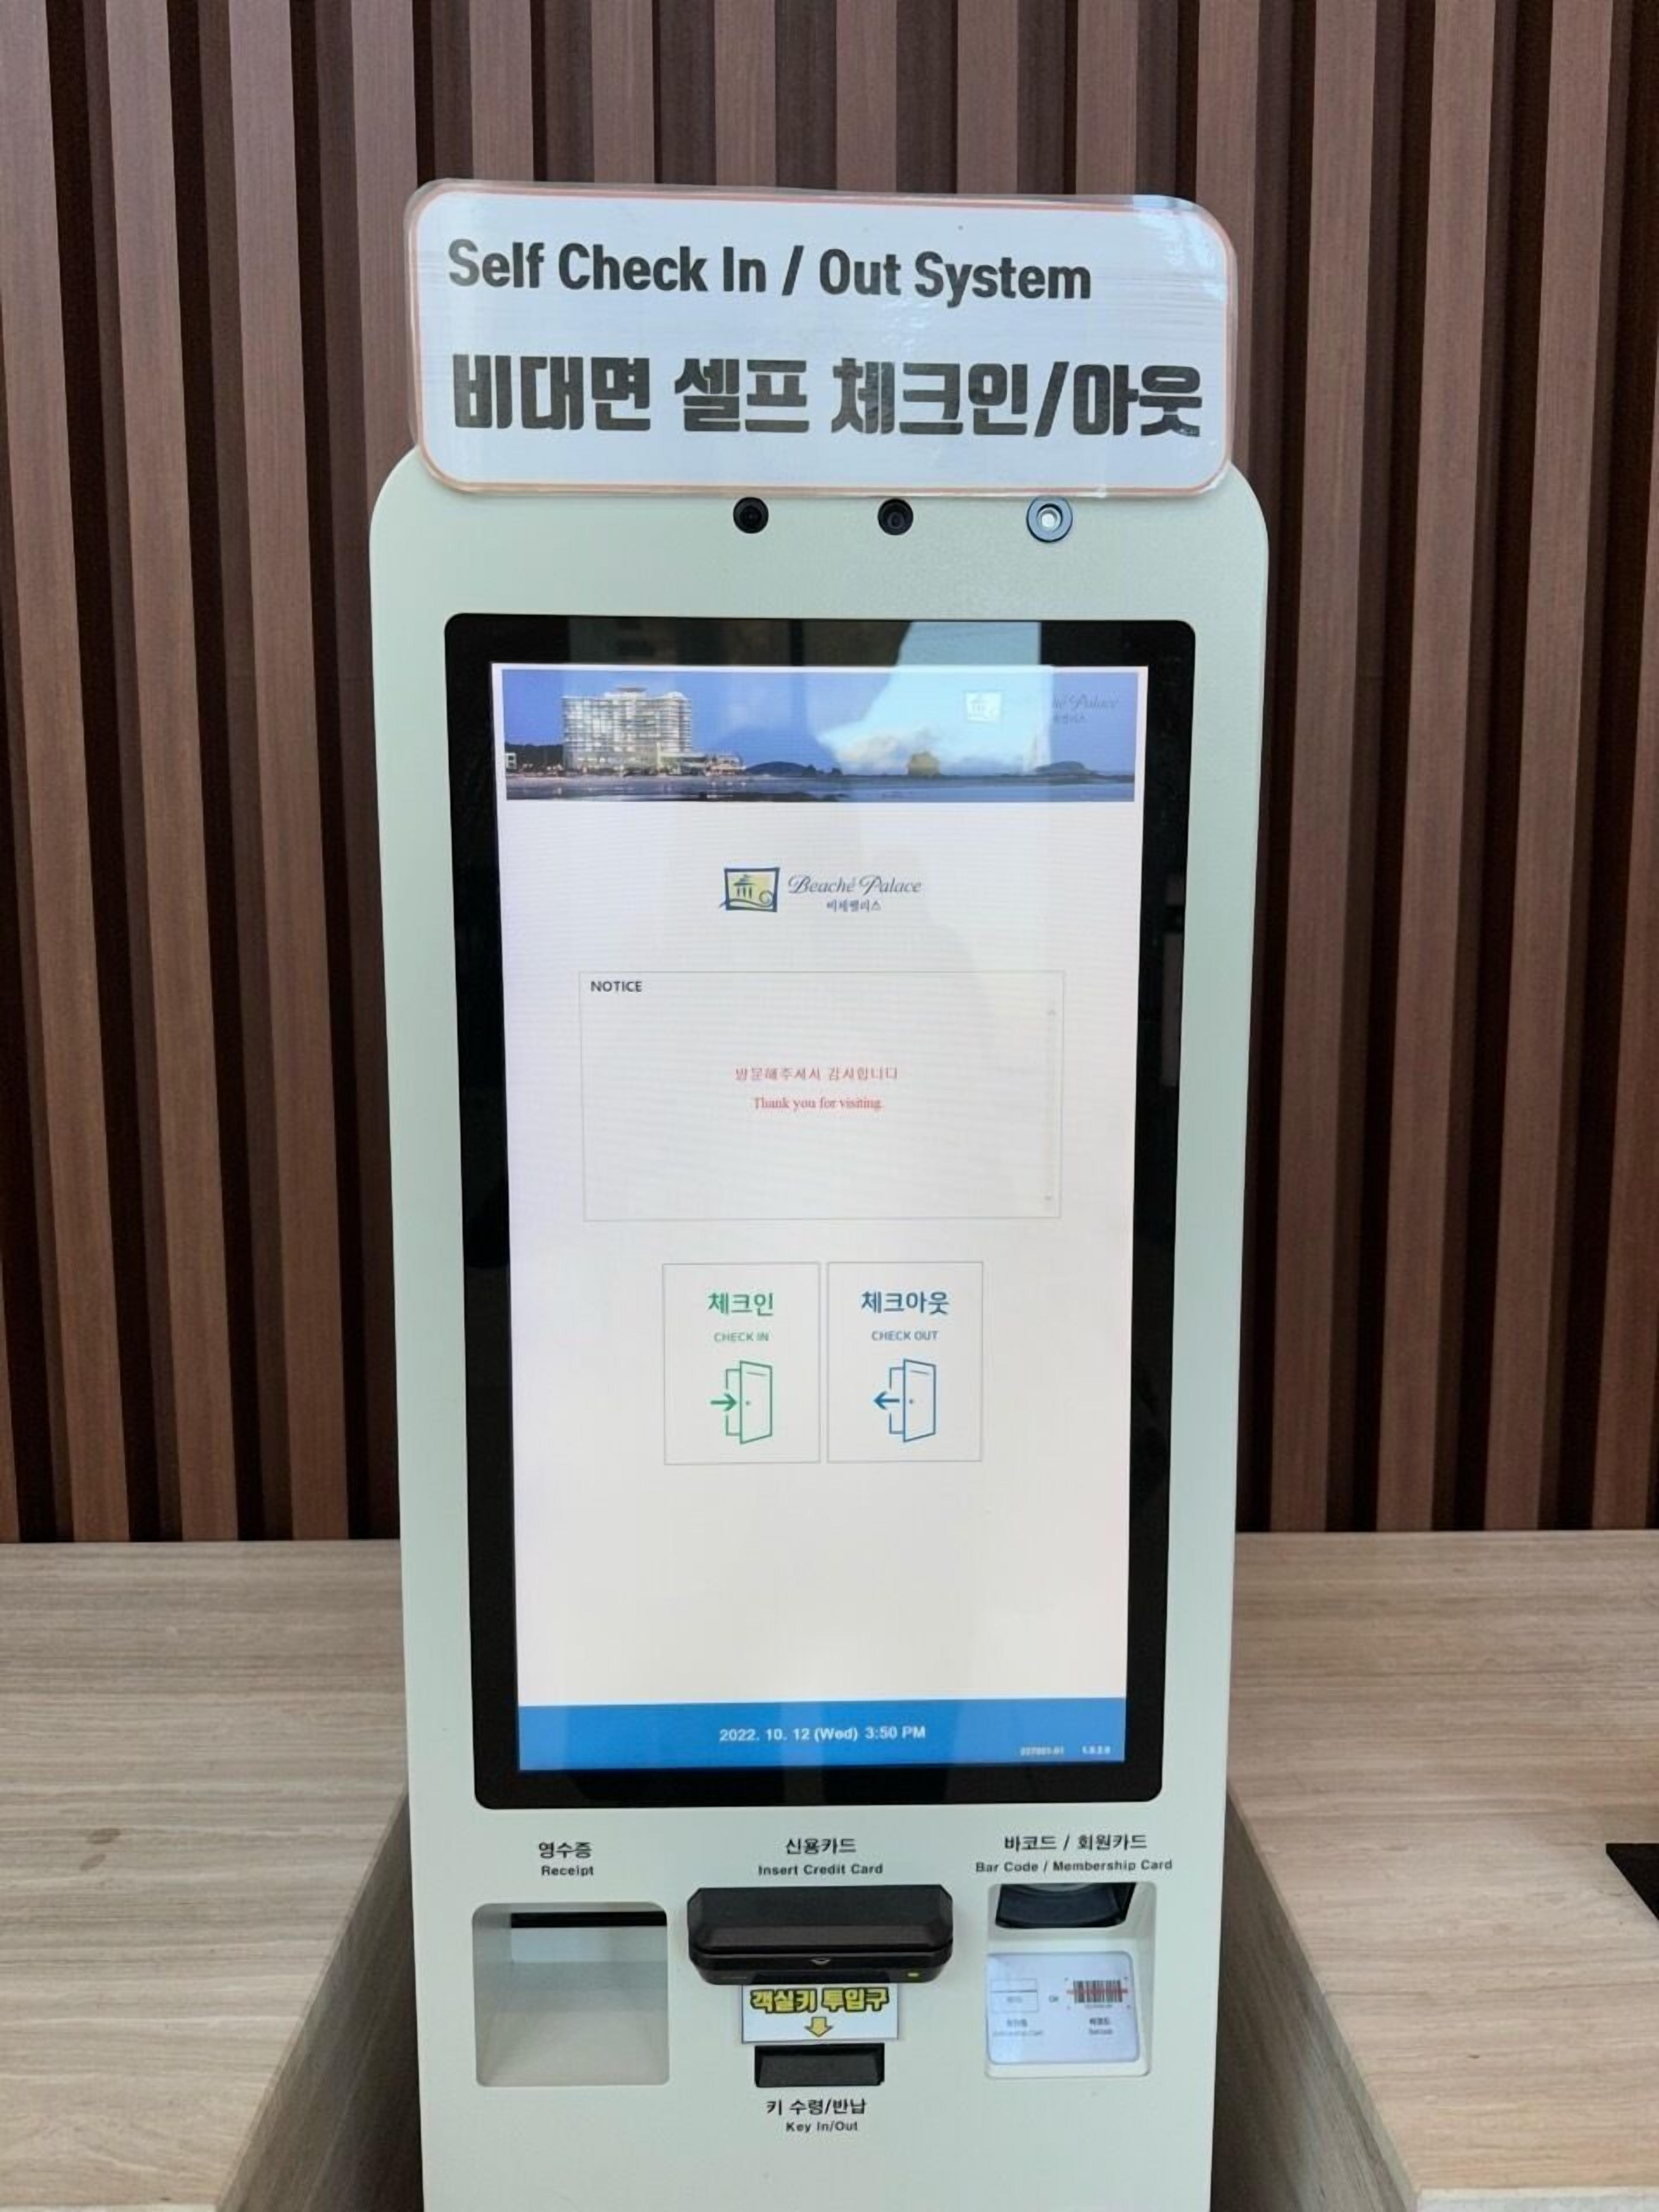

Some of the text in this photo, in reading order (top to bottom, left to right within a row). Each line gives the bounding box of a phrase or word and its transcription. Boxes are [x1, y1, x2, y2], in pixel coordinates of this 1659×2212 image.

[448, 238, 1091, 308] Self Check In / Out System
[452, 353, 1203, 437] 비대면 셀프 체크인/아웃
[859, 874, 923, 895] Palace
[590, 981, 642, 992] NOTICE
[755, 1097, 789, 1109] Thank
[793, 1099, 816, 1112] you
[820, 1096, 836, 1109] for
[708, 1292, 774, 1317] 체크인
[861, 1291, 949, 1316] 체크아웃
[714, 1331, 769, 1342] CHECK IN
[871, 1330, 939, 1341] CHECK OUT
[719, 1726, 926, 1742] 2022. 10. 12 (Wed) 3:50 PM
[539, 1842, 592, 1859] 영수증
[786, 1838, 856, 1854] 신용카드
[1004, 1834, 1147, 1852] 바코드 / 회원카드
[541, 1865, 594, 1876] Receipt
[758, 1863, 884, 1875] Insert Credit Card
[976, 1862, 999, 1872] Bar
[1004, 1861, 1038, 1872] Code
[1053, 1860, 1136, 1871] Membership
[1141, 1859, 1173, 1870] Card
[750, 1987, 890, 2013] 객실키 투입구
[766, 2098, 866, 2116] 키 수령/반납
[786, 2121, 858, 2133] Key In/Out
